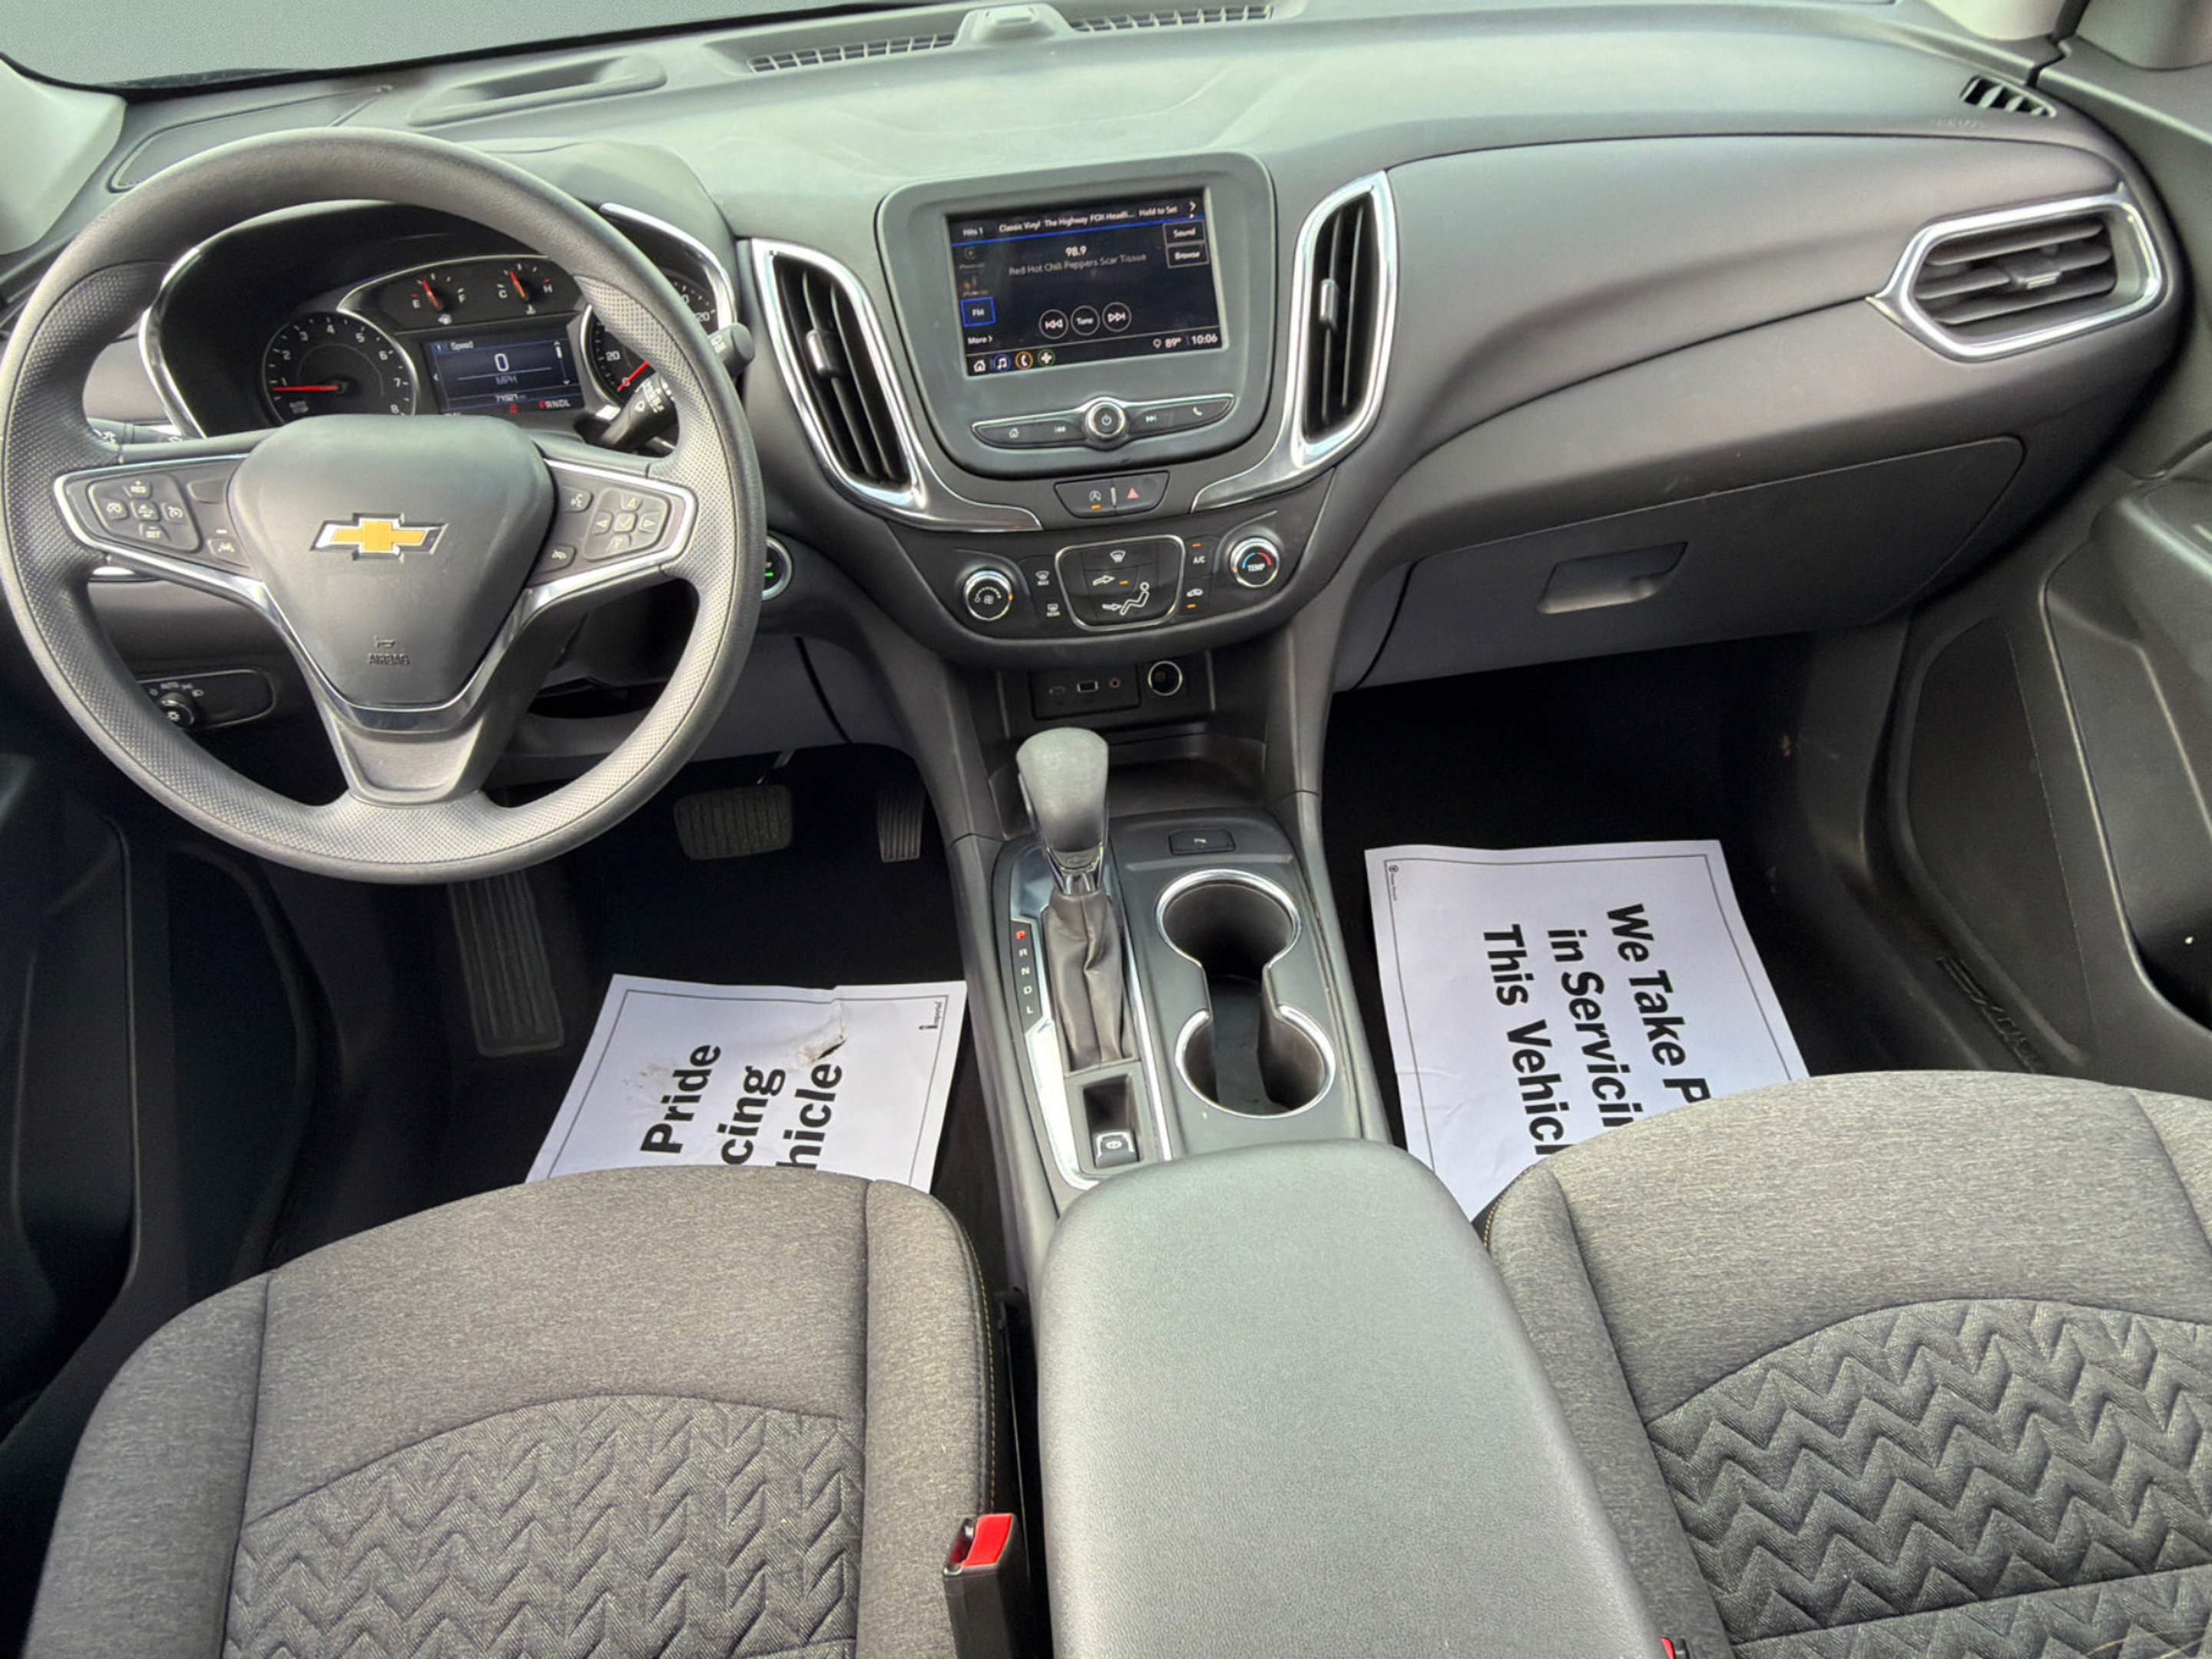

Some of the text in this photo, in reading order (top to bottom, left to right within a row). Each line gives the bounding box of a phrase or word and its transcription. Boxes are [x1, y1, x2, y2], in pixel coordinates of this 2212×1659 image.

[1058, 217, 1088, 227] Highway
[1090, 214, 1105, 222] FOX
[999, 224, 1023, 233] Classic
[1065, 245, 1087, 257] 98.9
[1009, 265, 1026, 276] Red
[1028, 263, 1043, 273] Hot
[1064, 258, 1098, 271] Peppers
[1100, 256, 1118, 266] Scar
[1120, 253, 1147, 263] Tissue
[543, 284, 553, 293] H
[499, 290, 508, 299] C
[412, 300, 421, 309] E
[326, 324, 336, 334] 4
[300, 331, 309, 341] 3
[356, 333, 365, 343] 5
[1191, 333, 1217, 344] 10:06
[282, 349, 291, 360] 2
[379, 350, 388, 360] 6
[606, 350, 621, 361] 20
[393, 377, 401, 387] 7
[390, 404, 399, 414] 8
[1015, 929, 1026, 940] P
[1606, 903, 1654, 963] We
[1547, 929, 1588, 962] in
[1482, 923, 1535, 1006] This
[1022, 966, 1030, 975] N
[1023, 985, 1032, 995] D
[1026, 1005, 1034, 1015] L
[1628, 969, 1687, 1067] Take
[640, 1045, 721, 1154] Pride
